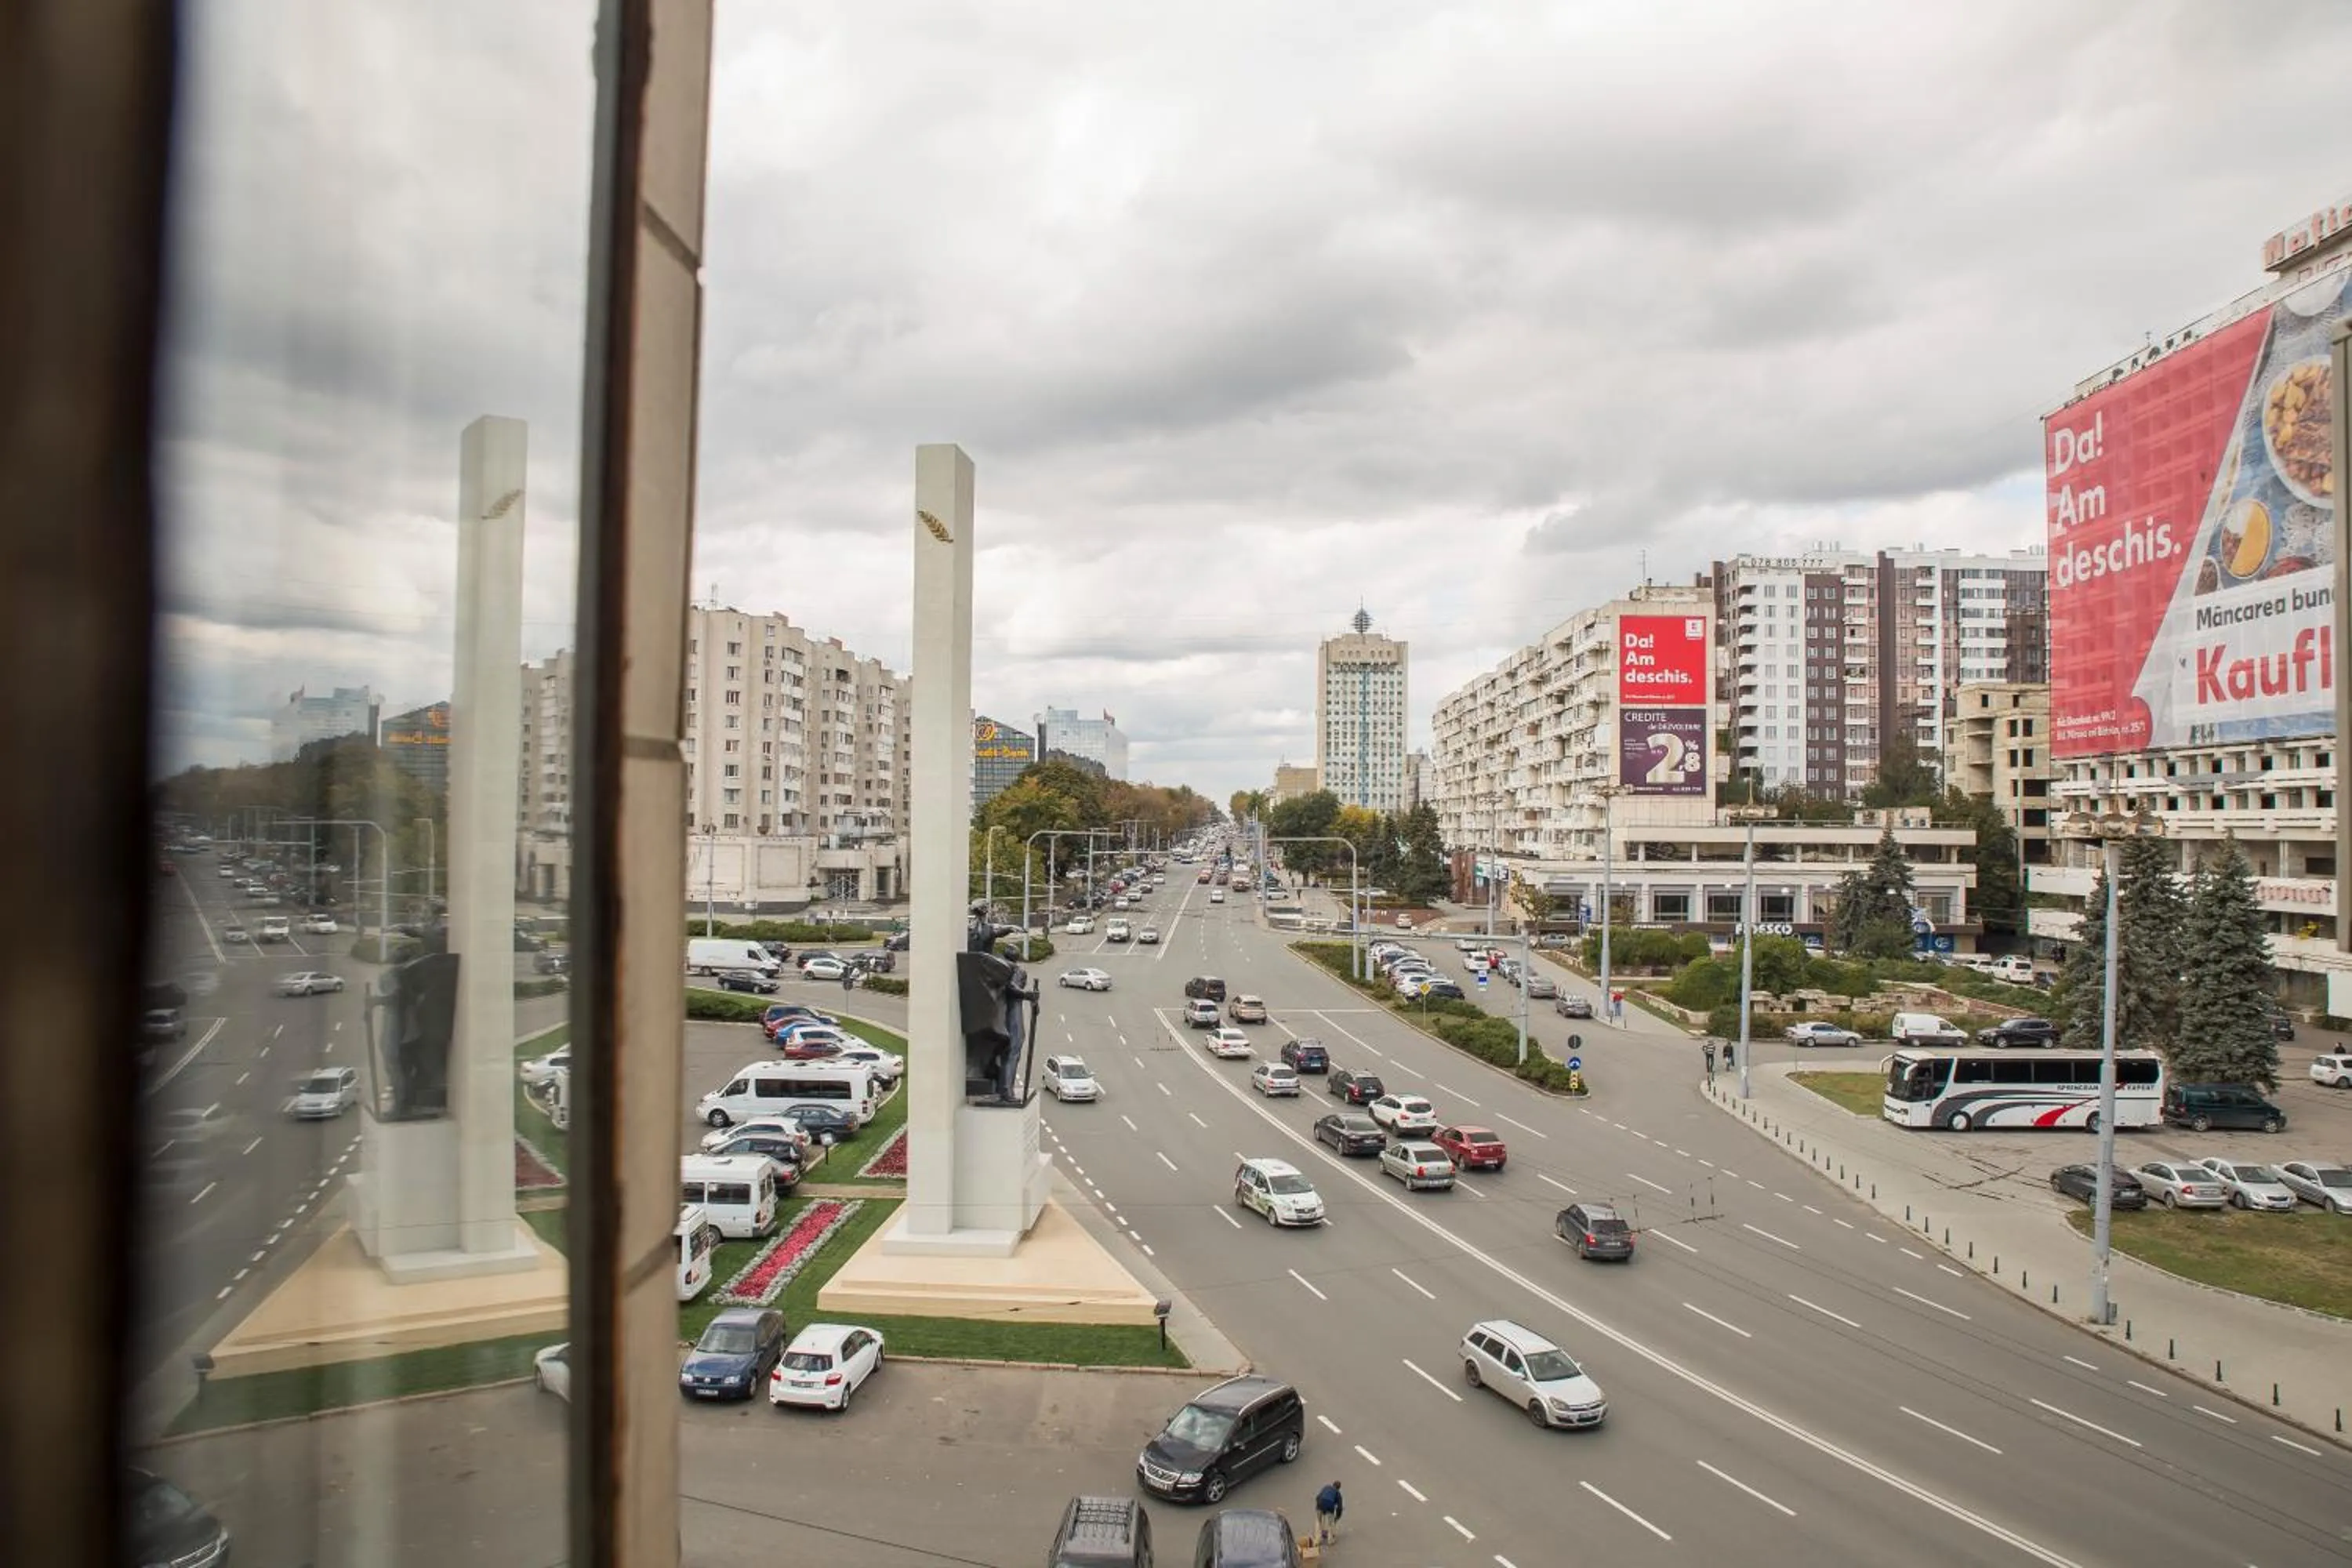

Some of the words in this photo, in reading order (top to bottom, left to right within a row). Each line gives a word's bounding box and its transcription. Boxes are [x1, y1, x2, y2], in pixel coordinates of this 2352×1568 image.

[2055, 411, 2103, 474] Da!
[2057, 482, 2106, 535] Am
[2057, 517, 2182, 588] deschis.
[2292, 587, 2336, 613] bun
[1625, 633, 1654, 648] Da!
[1625, 651, 1655, 666] Am
[1625, 669, 1693, 684] deschis.
[1624, 712, 1667, 722] CREDITE
